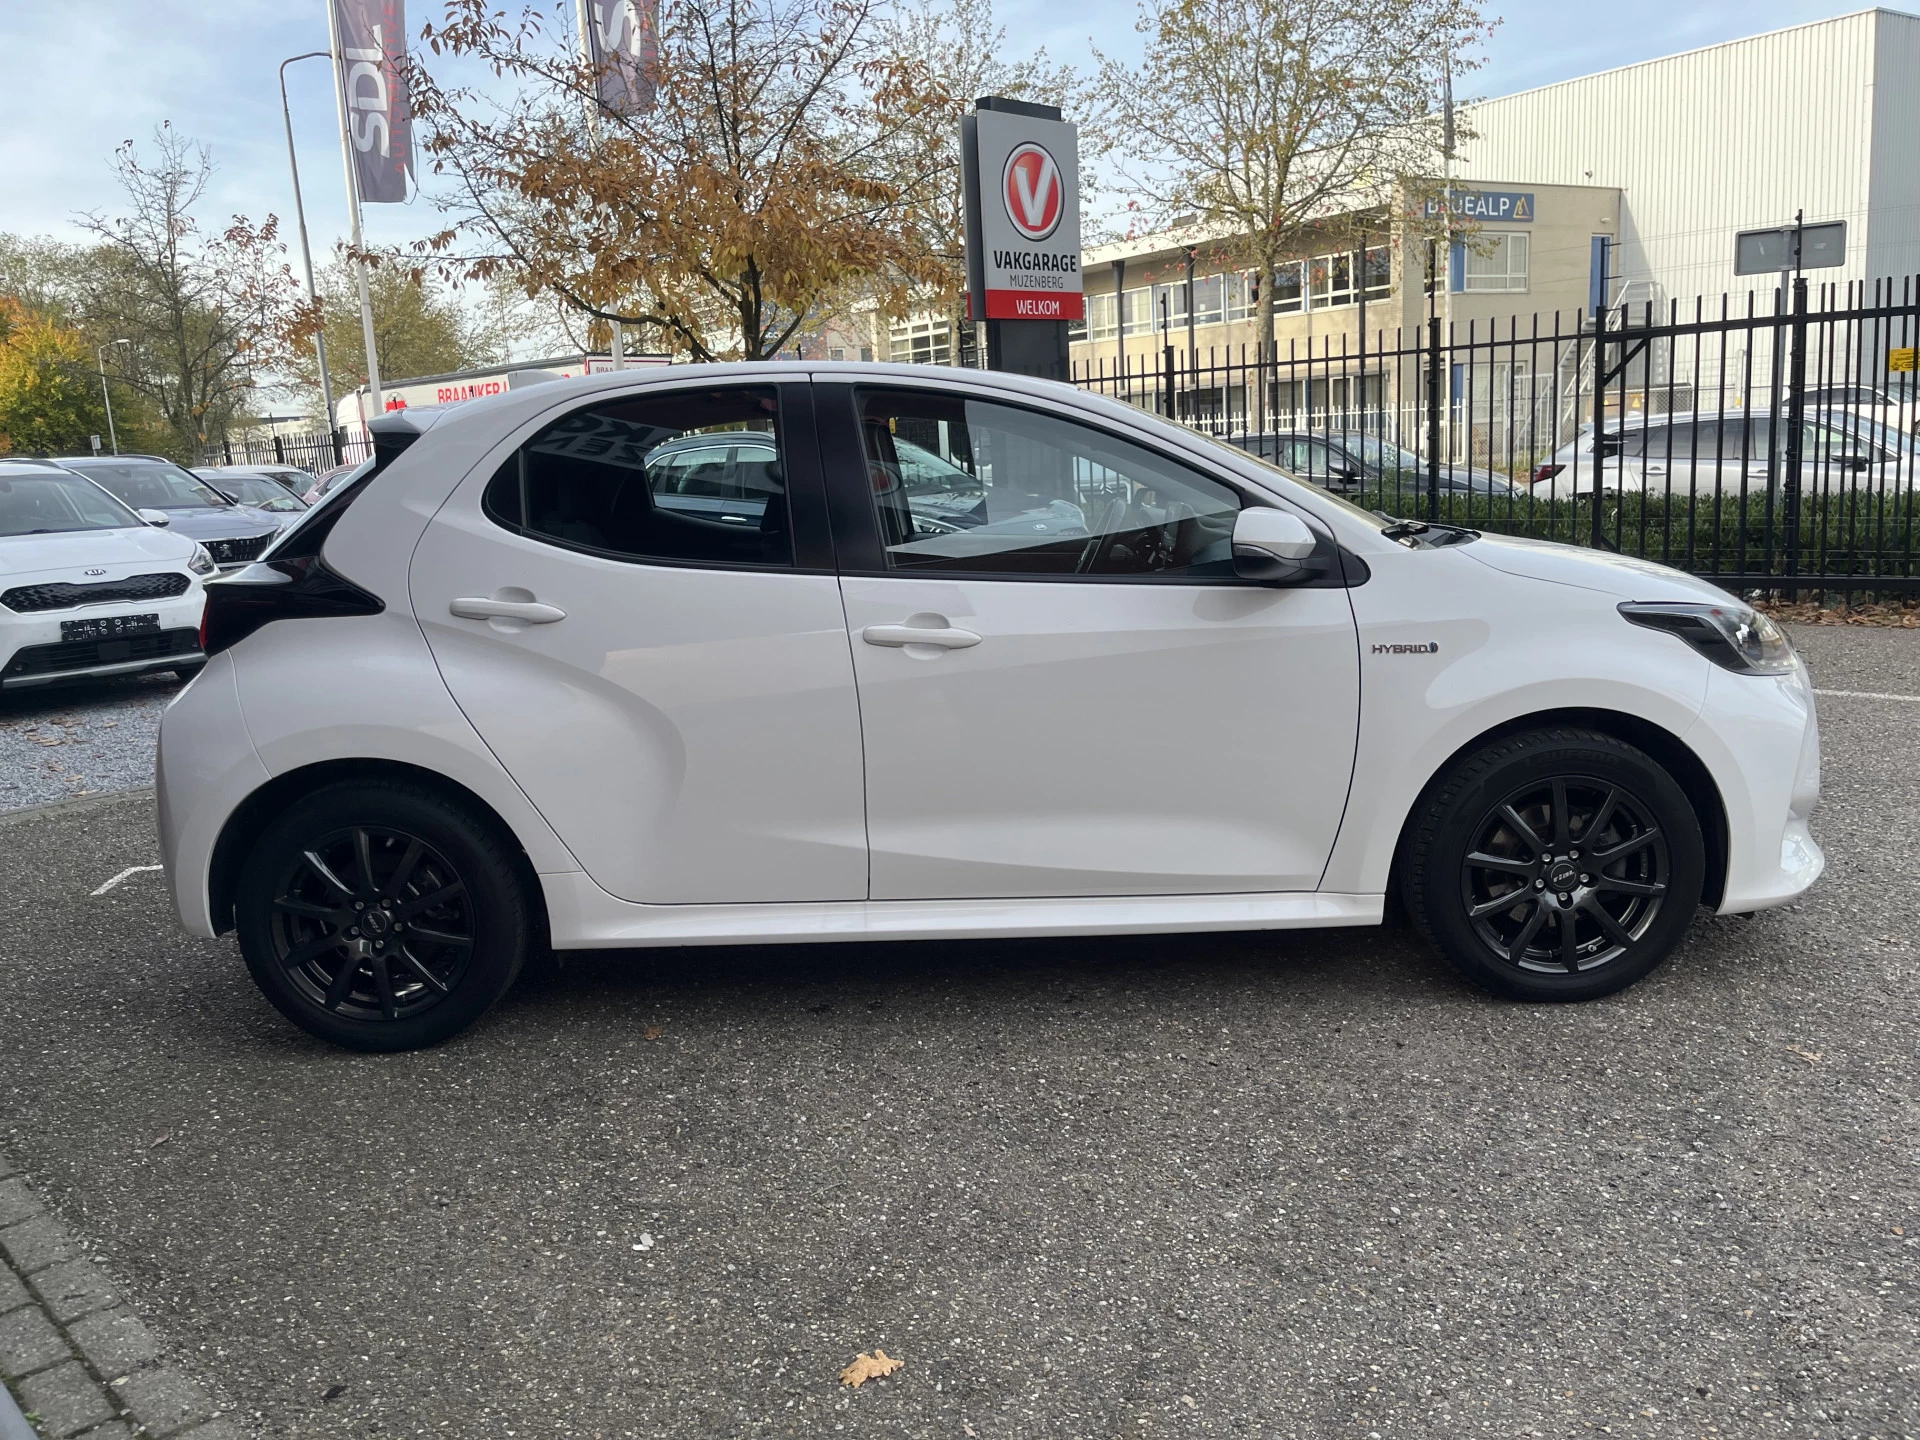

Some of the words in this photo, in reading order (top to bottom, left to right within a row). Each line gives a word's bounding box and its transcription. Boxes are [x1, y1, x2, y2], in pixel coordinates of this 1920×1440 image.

[346, 24, 390, 159] SDL
[1427, 195, 1510, 216] BUEALP
[994, 250, 1077, 273] VAKGARAGE
[1009, 274, 1064, 289] MUZENBERG
[1016, 300, 1060, 316] WELKOM
[1372, 644, 1428, 654] HYBRID
